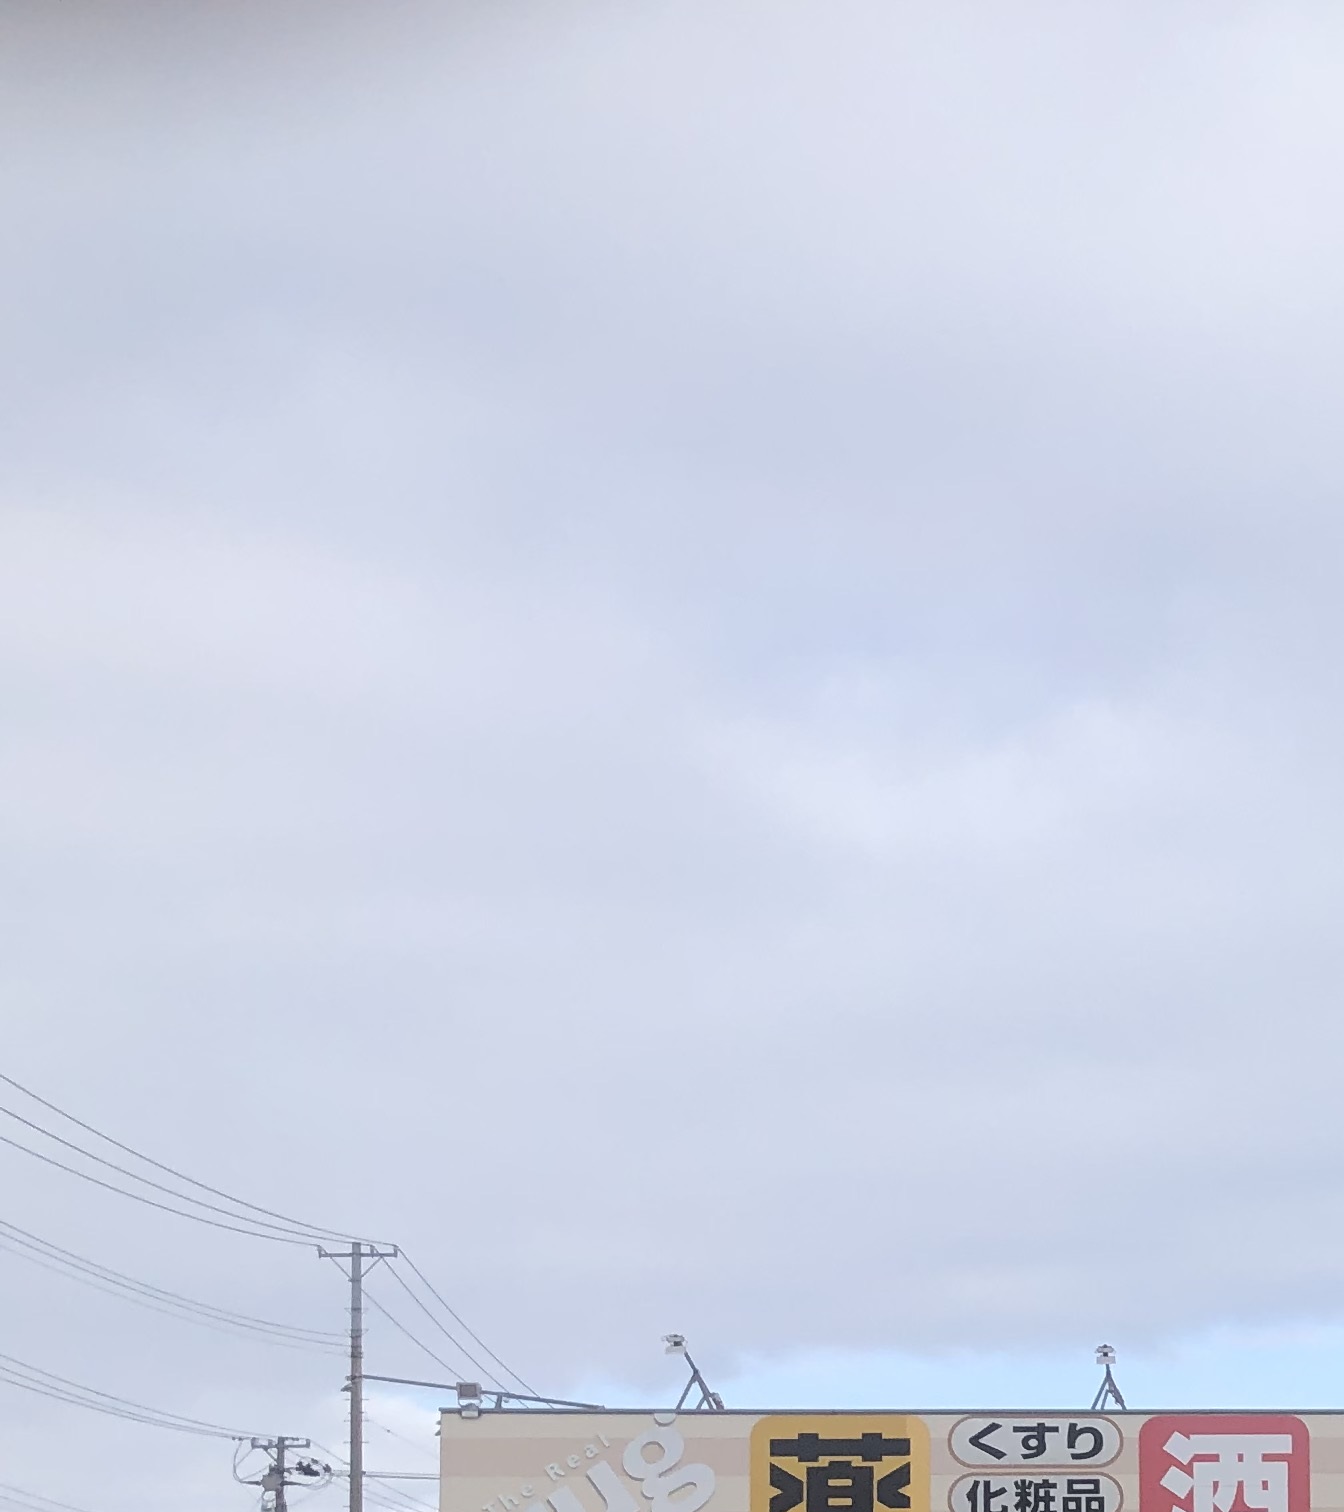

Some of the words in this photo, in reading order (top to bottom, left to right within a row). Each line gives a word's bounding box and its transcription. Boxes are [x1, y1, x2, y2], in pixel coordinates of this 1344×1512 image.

[544, 1432, 611, 1481] Real
[968, 1421, 1105, 1462] くすり
